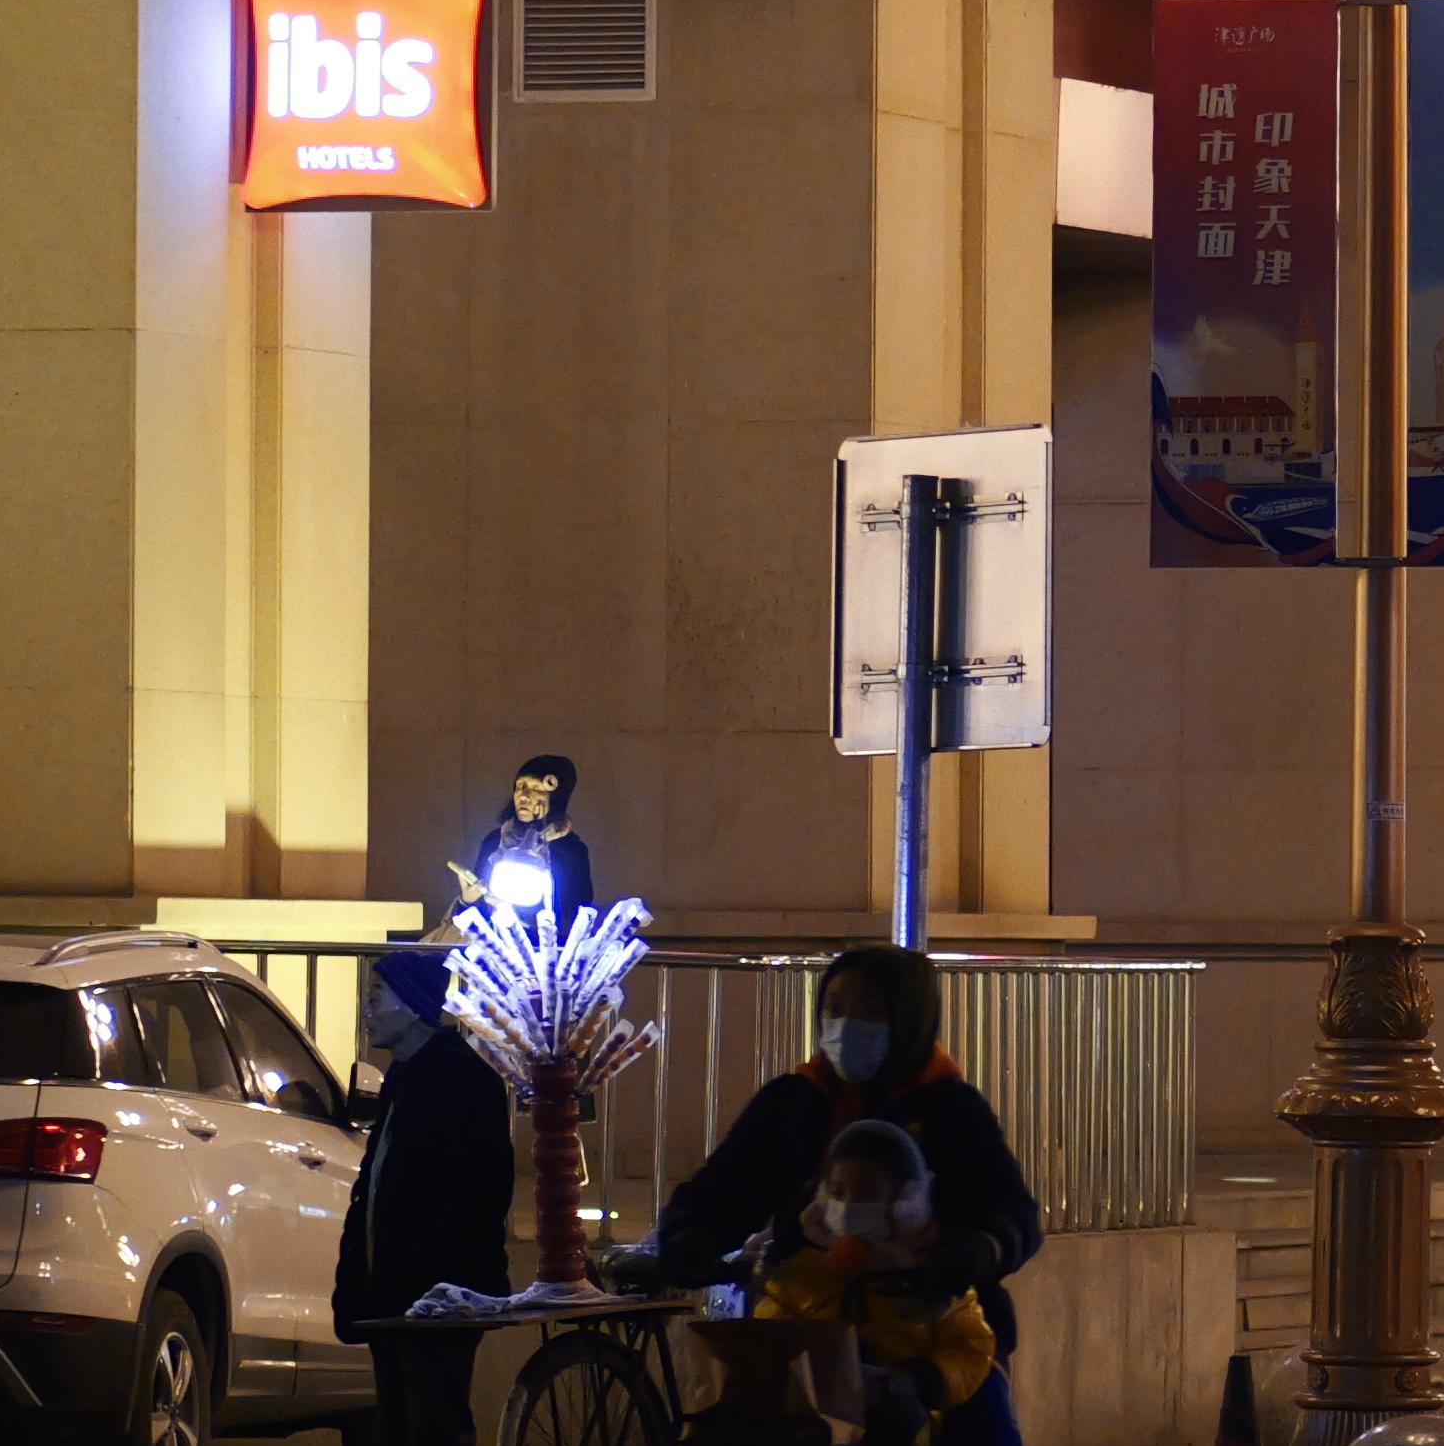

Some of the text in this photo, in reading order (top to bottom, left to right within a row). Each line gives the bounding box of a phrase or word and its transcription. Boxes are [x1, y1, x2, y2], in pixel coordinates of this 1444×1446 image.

[267, 11, 434, 119] ibis
[297, 146, 395, 171] HOTELS
[1196, 82, 1238, 258] 城市封面
[1252, 111, 1294, 286] 印象天津
